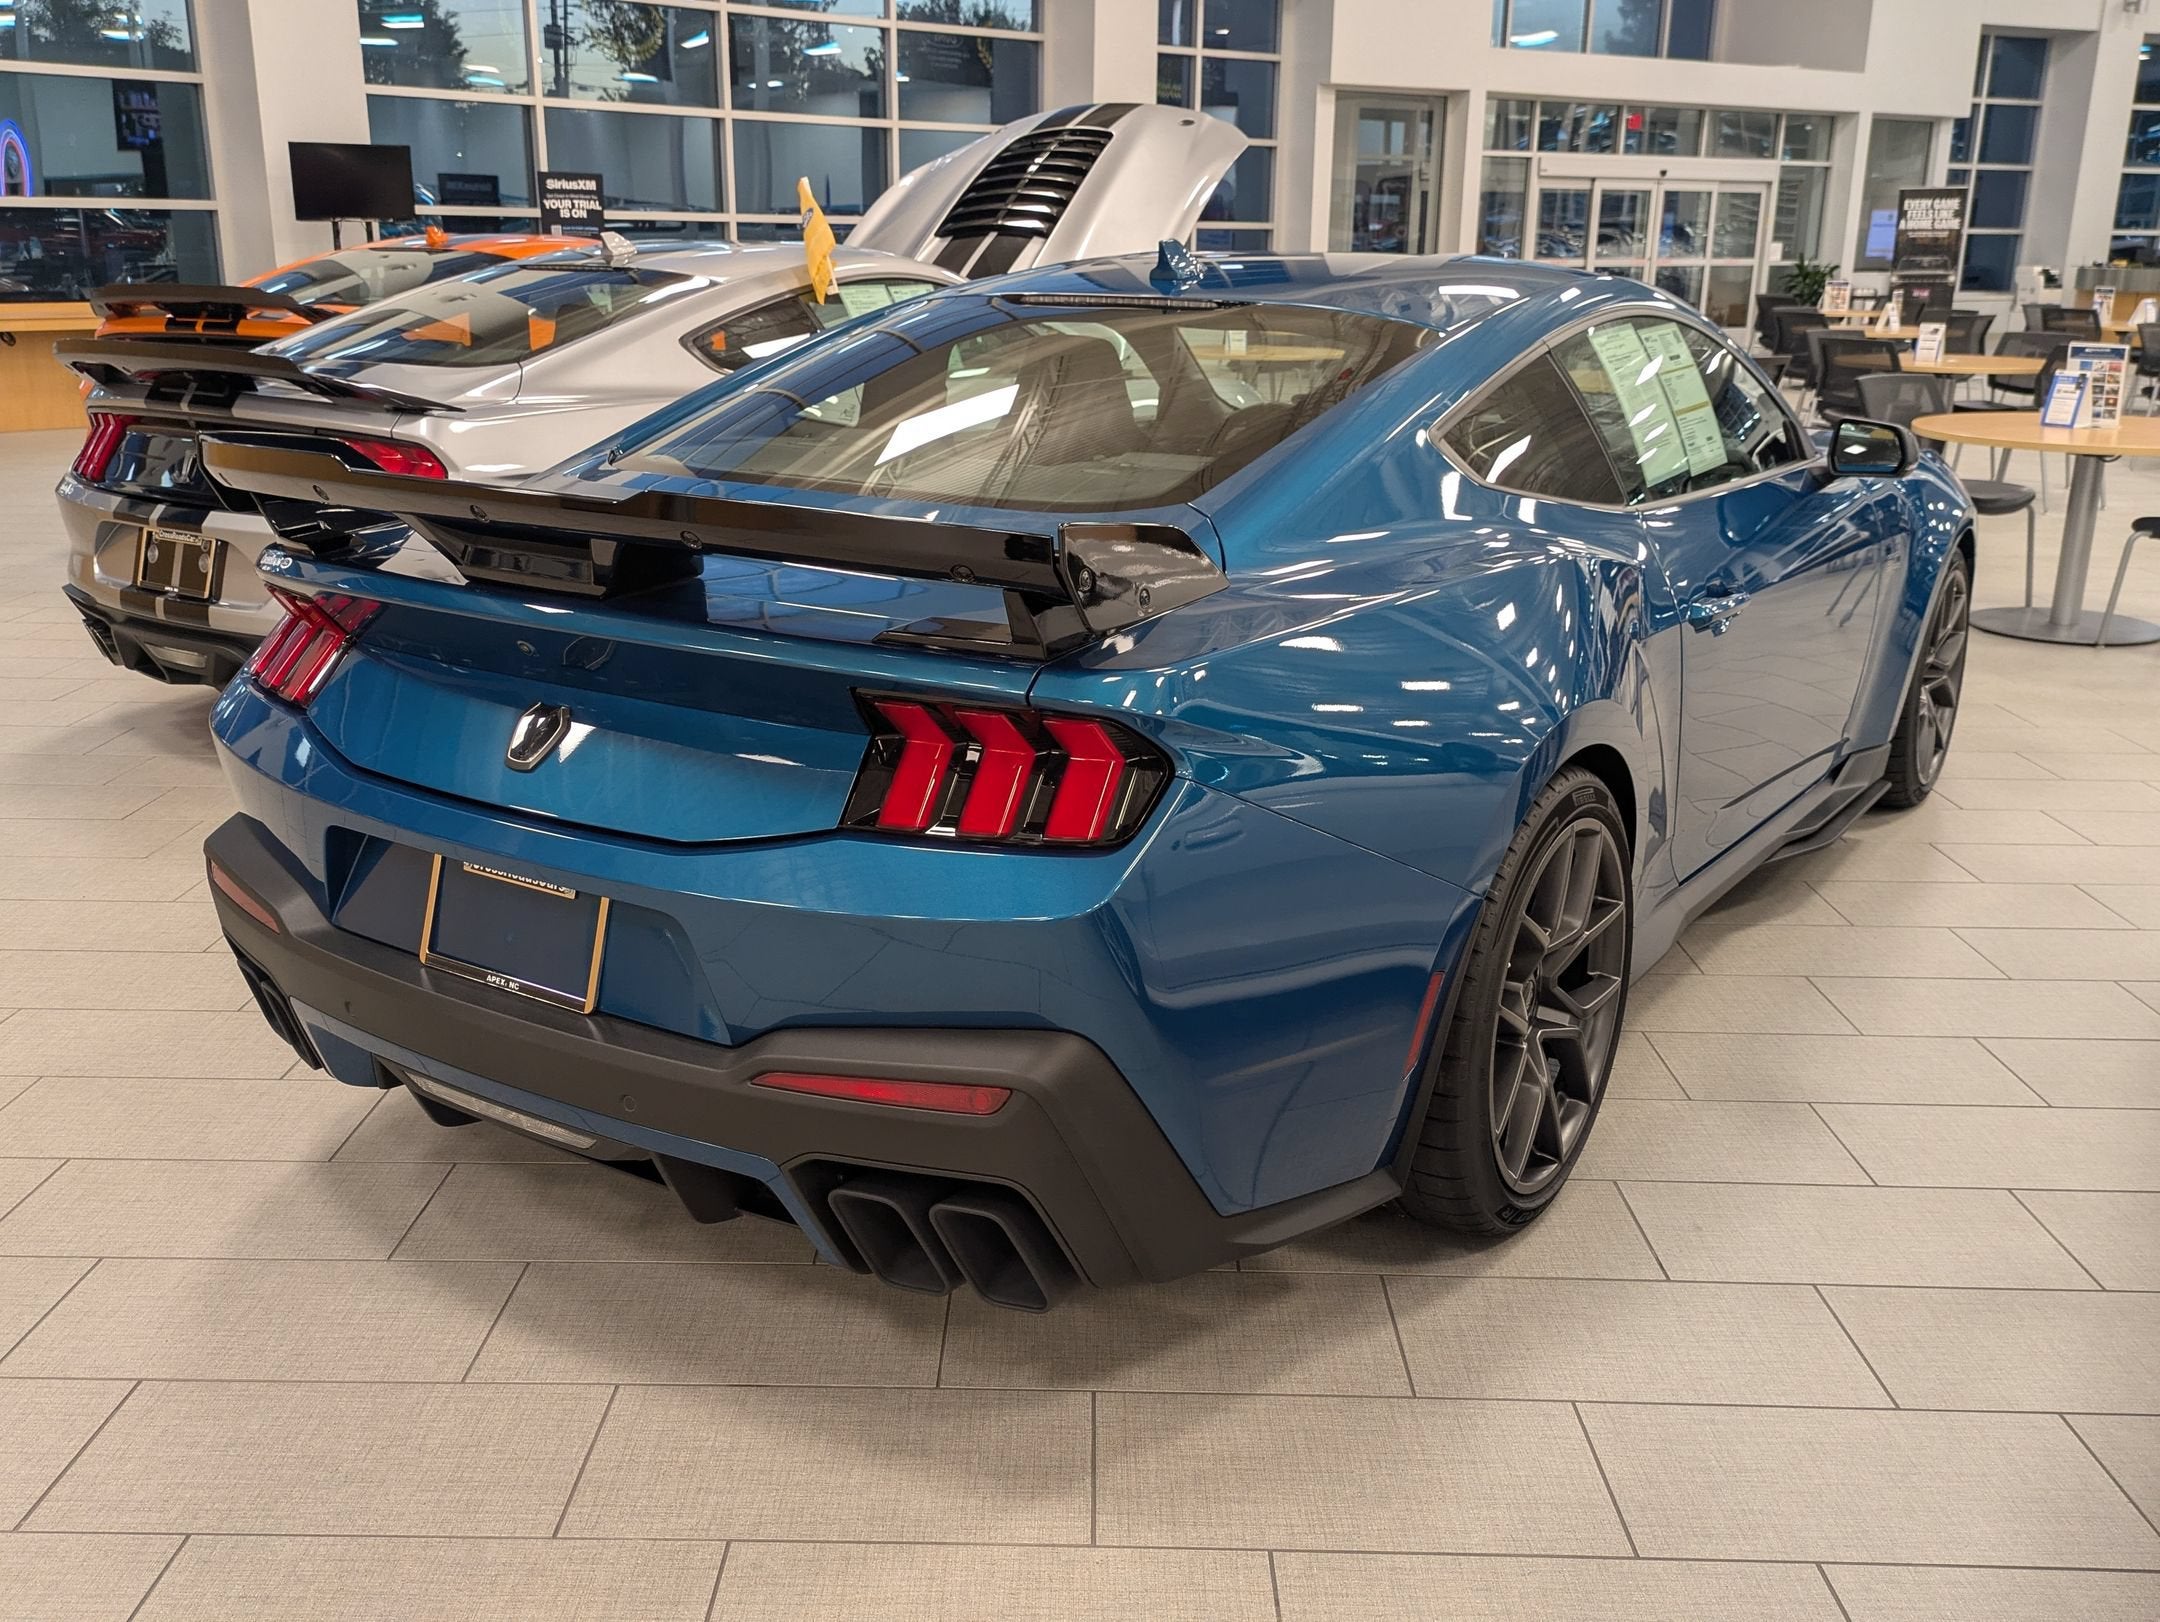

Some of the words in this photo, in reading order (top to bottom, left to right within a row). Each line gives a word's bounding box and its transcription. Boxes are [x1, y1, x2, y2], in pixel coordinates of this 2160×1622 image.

[545, 178, 597, 191] SiriusXM
[543, 199, 572, 209] YOUR
[573, 200, 602, 210] TRIAL
[1904, 198, 1933, 210] EVERY
[1933, 197, 1961, 210] GAME
[560, 209, 571, 218] IS
[571, 209, 587, 218] ON
[1907, 209, 1933, 220] FEELS
[1934, 209, 1955, 220] LIKE
[1899, 218, 1906, 230] A
[1906, 219, 1933, 230] HOME
[1933, 218, 1961, 230] GAME
[486, 974, 507, 987] APEX,
[508, 981, 520, 991] NC
